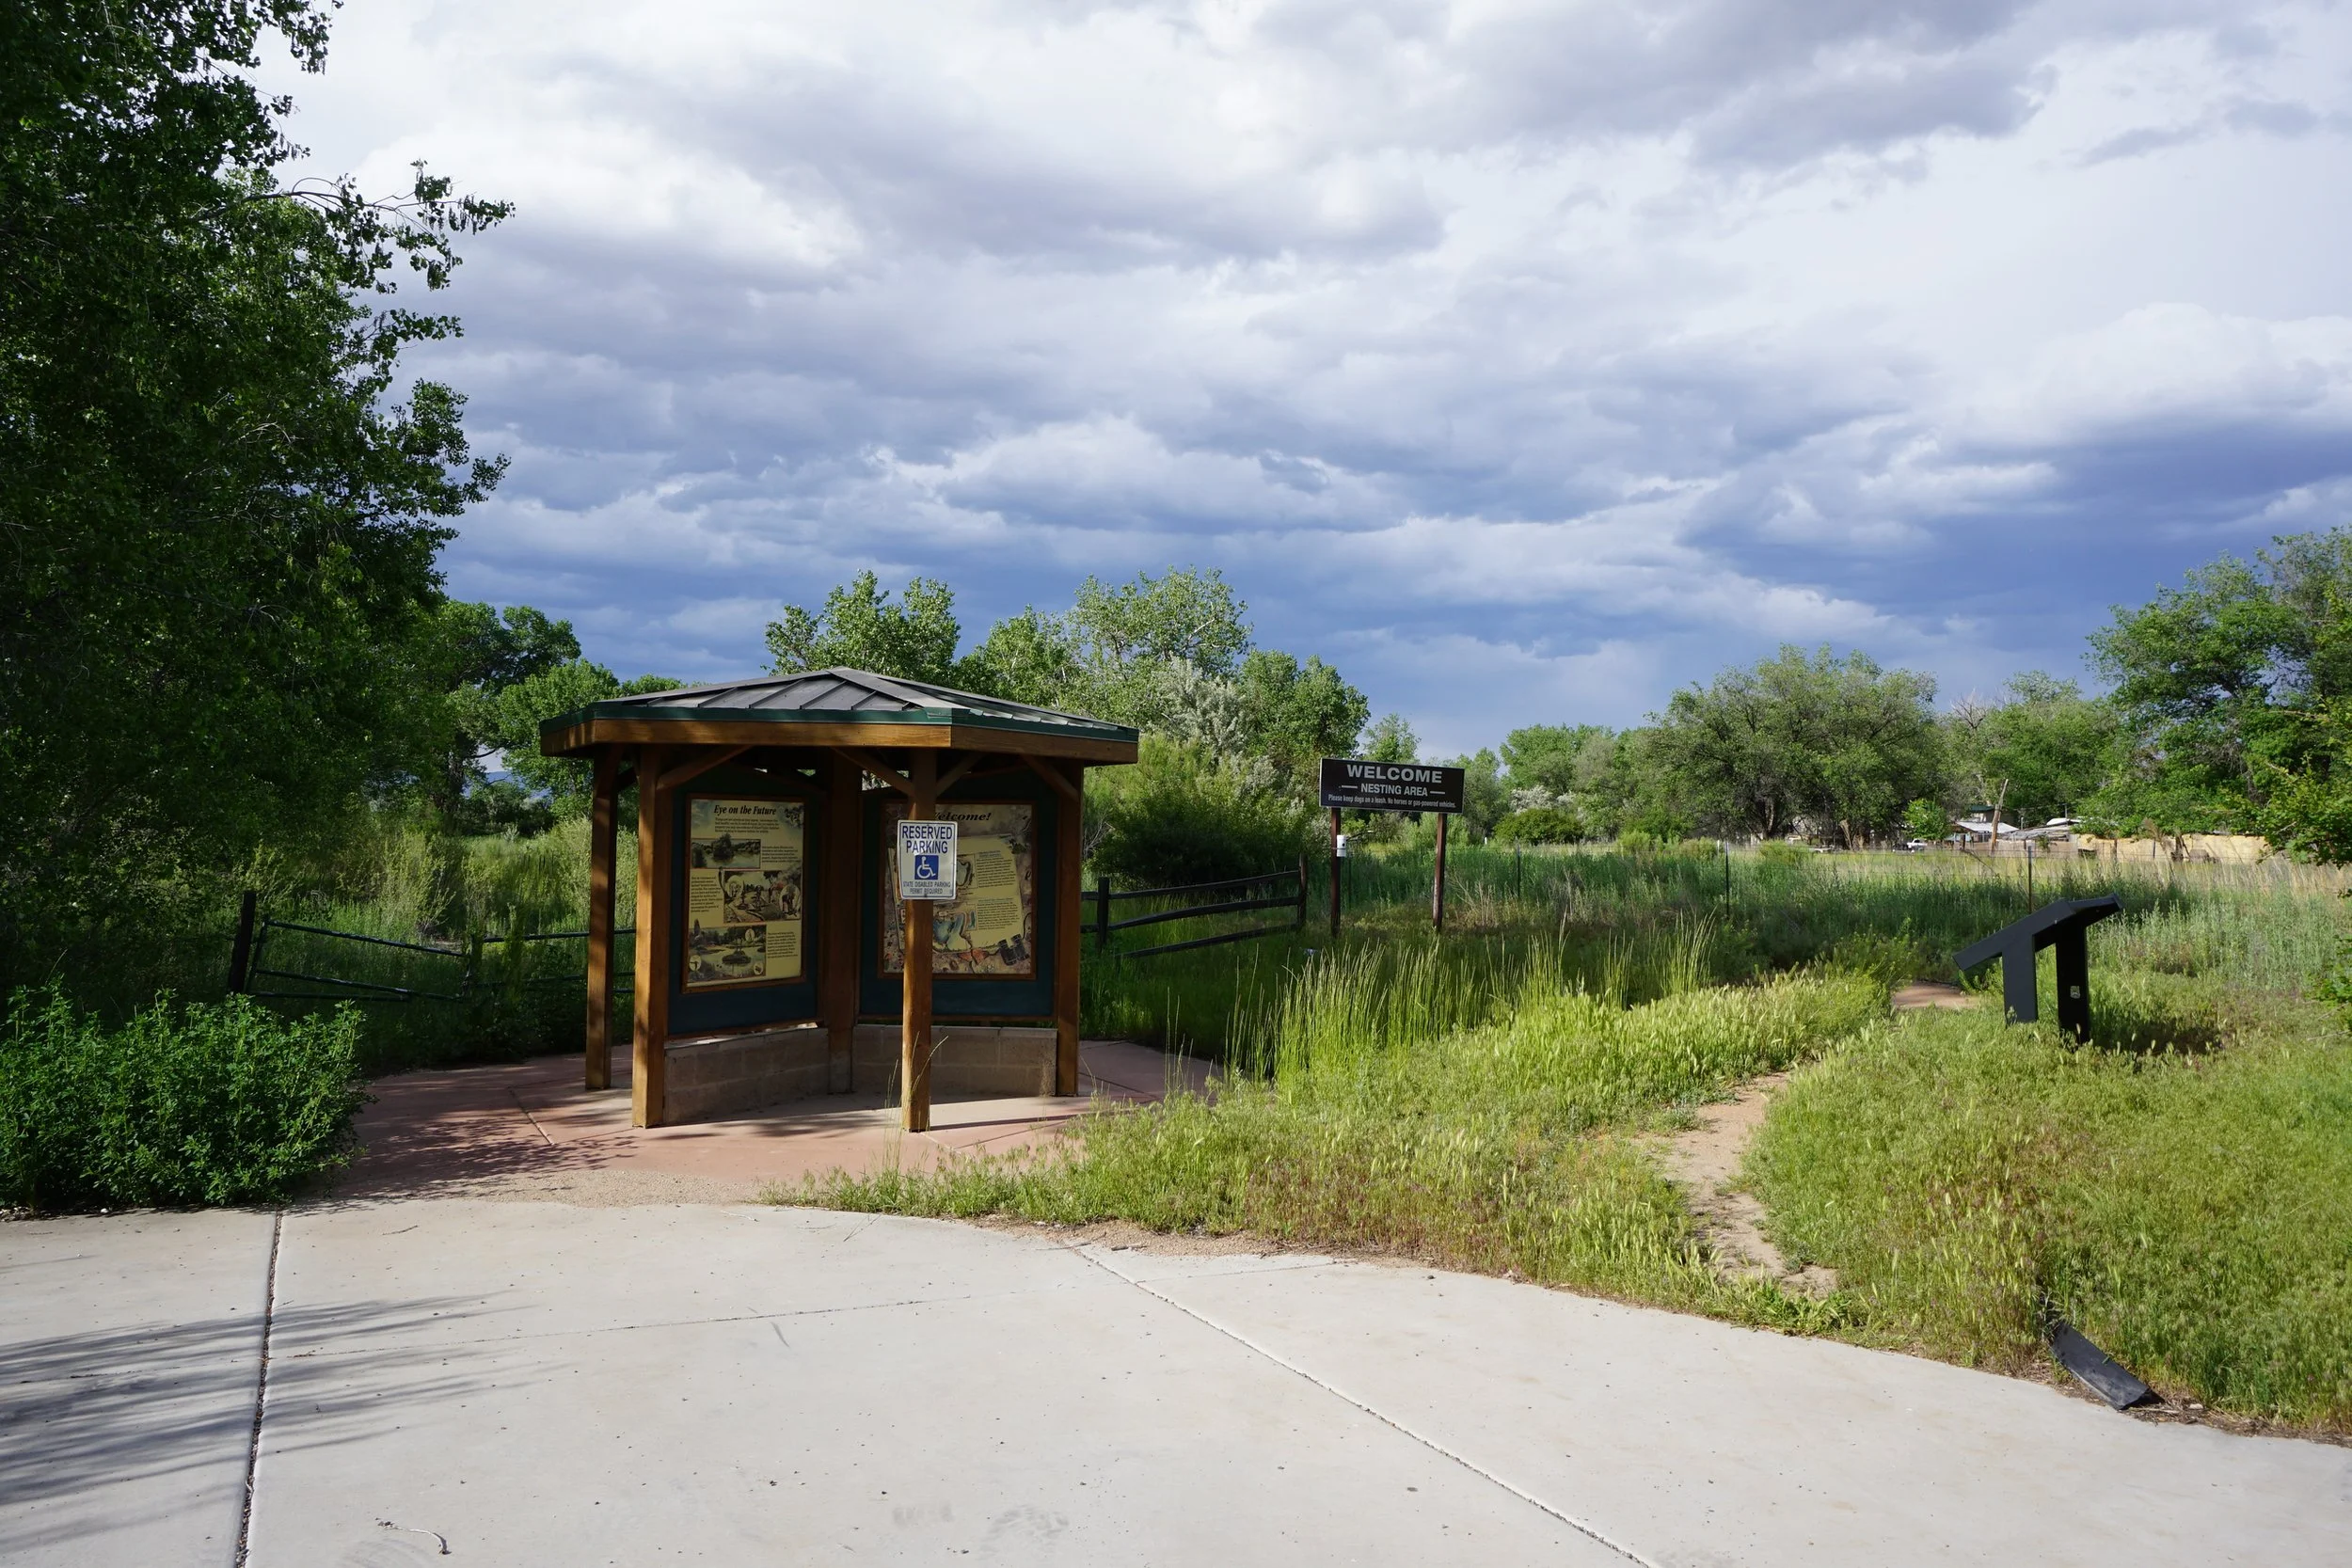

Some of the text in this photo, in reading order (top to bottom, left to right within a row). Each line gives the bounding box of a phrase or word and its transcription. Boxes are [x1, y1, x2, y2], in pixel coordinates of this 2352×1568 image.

[1346, 764, 1443, 784] WELCOME
[1360, 783, 1428, 797] NESTING AREA
[1354, 796, 1364, 804] dogs
[1413, 800, 1438, 808] gas-powered
[714, 804, 727, 816] Eye
[740, 805, 752, 815] the
[753, 806, 777, 815] Future
[901, 825, 953, 840] RESERVED
[906, 840, 948, 854] PARKING
